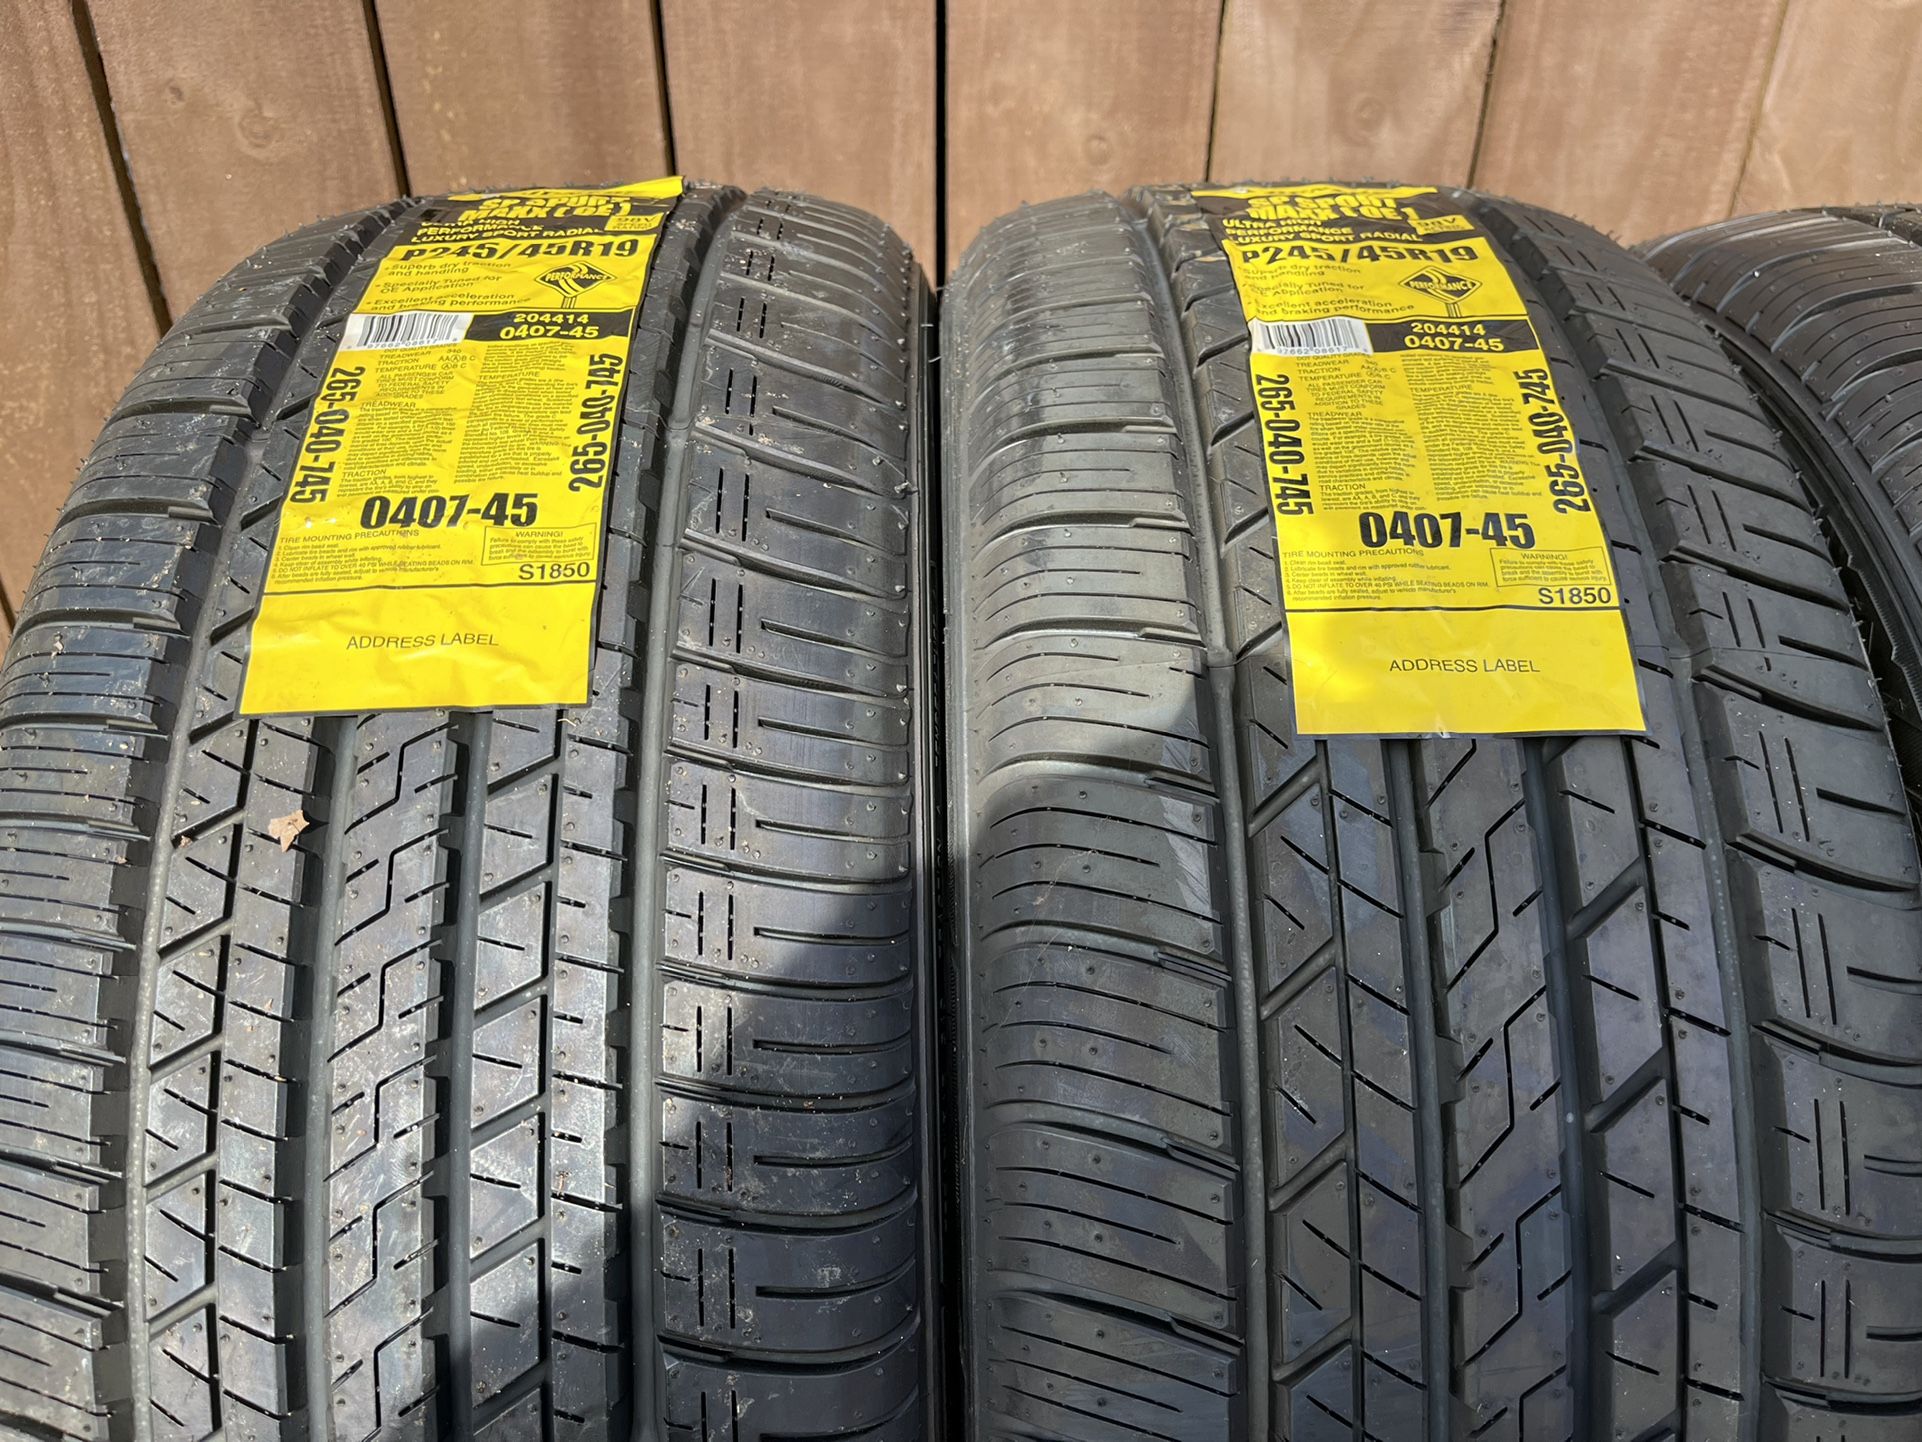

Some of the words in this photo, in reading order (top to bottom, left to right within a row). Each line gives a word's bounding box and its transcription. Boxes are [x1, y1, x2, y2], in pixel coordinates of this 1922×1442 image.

[1222, 219, 1277, 228] ULTRA
[411, 233, 479, 243] LUXURY
[482, 230, 539, 238] SPORT
[1225, 225, 1354, 236] PERFORMANCE
[1299, 232, 1355, 242] SPORT
[1360, 232, 1423, 241] RADIAL
[401, 239, 639, 261] P245/45R19
[1242, 245, 1479, 265] P245/45R19
[391, 262, 437, 271] Superb
[439, 261, 462, 270] dry
[463, 260, 512, 269] traction
[1290, 264, 1310, 273] dry
[1313, 265, 1361, 274] traction
[415, 266, 470, 278] handling
[383, 279, 440, 290] Specially
[442, 276, 481, 285] Tuned
[402, 282, 474, 293] Application
[1306, 281, 1345, 290] Tuned
[1272, 287, 1345, 297] Application
[374, 296, 433, 306] Excellent
[434, 293, 515, 302] acceleration
[1314, 297, 1393, 308] acceleration
[1281, 305, 1330, 316] braking
[1333, 303, 1416, 314] performance
[513, 312, 589, 324] 204414
[500, 325, 600, 340] 0407-45
[1410, 322, 1487, 336] 204414
[1404, 335, 1505, 351] 0407-45
[380, 351, 431, 359] TREADWEAR
[375, 363, 437, 373] TEMPERATURE
[377, 358, 419, 366] TRACTION
[1296, 359, 1350, 367] TREADWEAR
[478, 371, 540, 380] TEMPERATURE
[1298, 373, 1362, 381] TEMPERATURE
[1409, 384, 1473, 393] TEMPERATURE
[568, 353, 624, 492] 265-040-745
[290, 366, 366, 504] 265-040-745
[1513, 368, 1592, 514] 265-040-745
[1256, 374, 1315, 515] 265-040-745
[342, 469, 387, 478] TRACTION
[1320, 483, 1366, 491] TRACTION
[360, 492, 539, 529] 0407-45
[302, 533, 352, 542] MOUNTING
[354, 529, 420, 539] PRECAUTIONS
[516, 530, 564, 538] WARNING!
[1359, 511, 1535, 549] 0407-45
[1359, 547, 1424, 556] PRECAUTIONS
[1520, 552, 1568, 560] WARNING!
[518, 561, 590, 580] S1850
[1538, 586, 1611, 605] S1850
[346, 633, 435, 650] ADDRESS
[440, 633, 499, 647] LABEL
[1389, 658, 1478, 673] ADDRESS
[1483, 658, 1541, 673] LABEL
